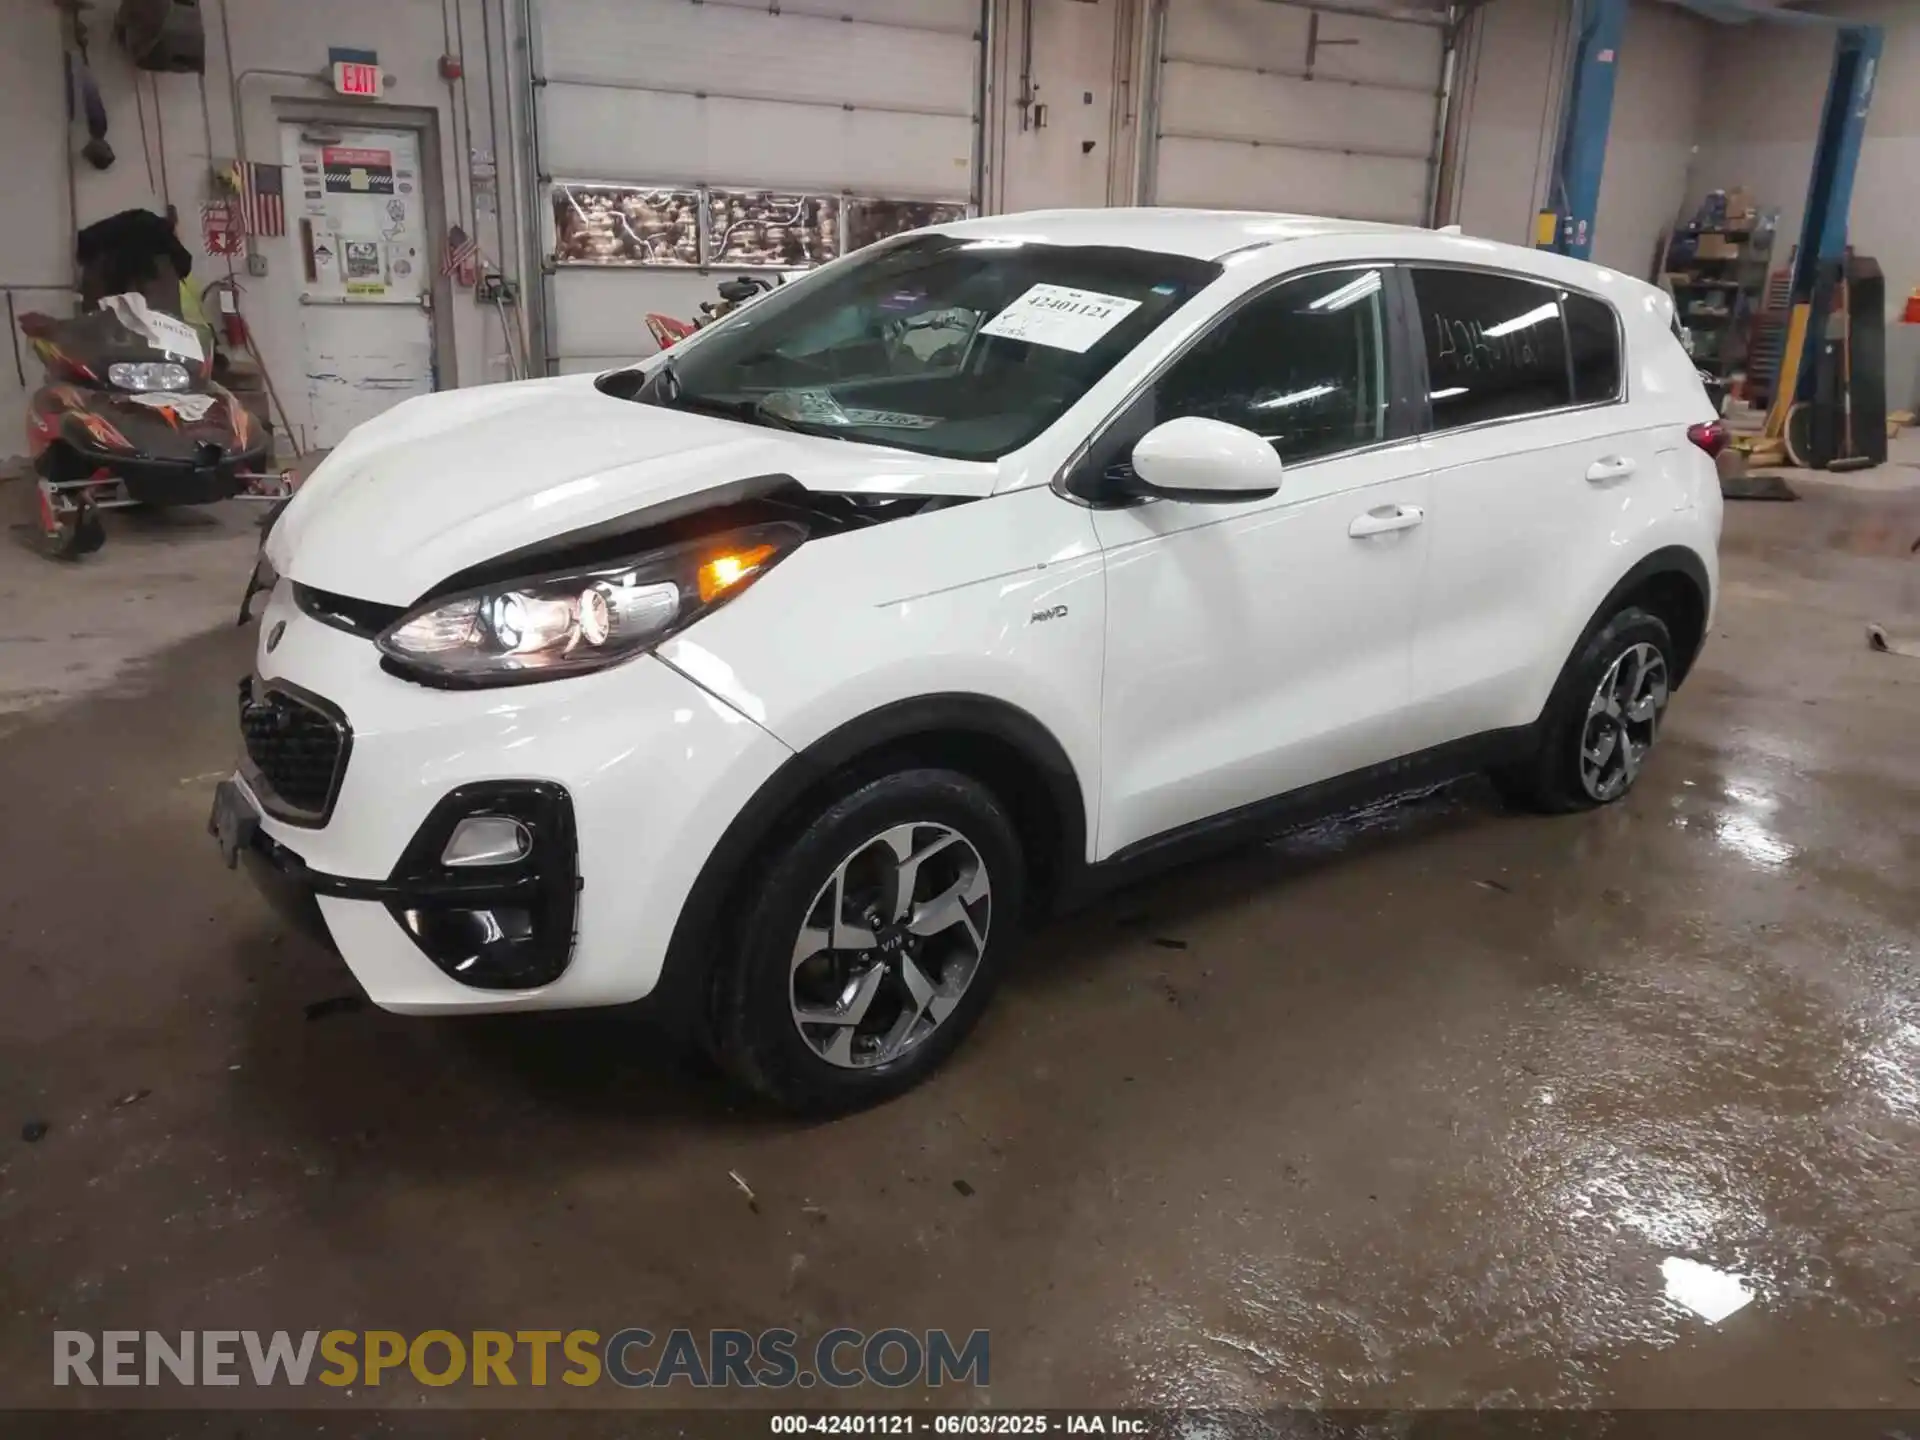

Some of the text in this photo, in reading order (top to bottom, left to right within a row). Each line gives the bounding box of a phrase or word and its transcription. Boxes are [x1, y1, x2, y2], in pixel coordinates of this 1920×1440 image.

[343, 64, 376, 93] EXIT
[1028, 296, 1111, 319] 42401121
[1031, 604, 1068, 624] AWD
[881, 934, 902, 952] KIA
